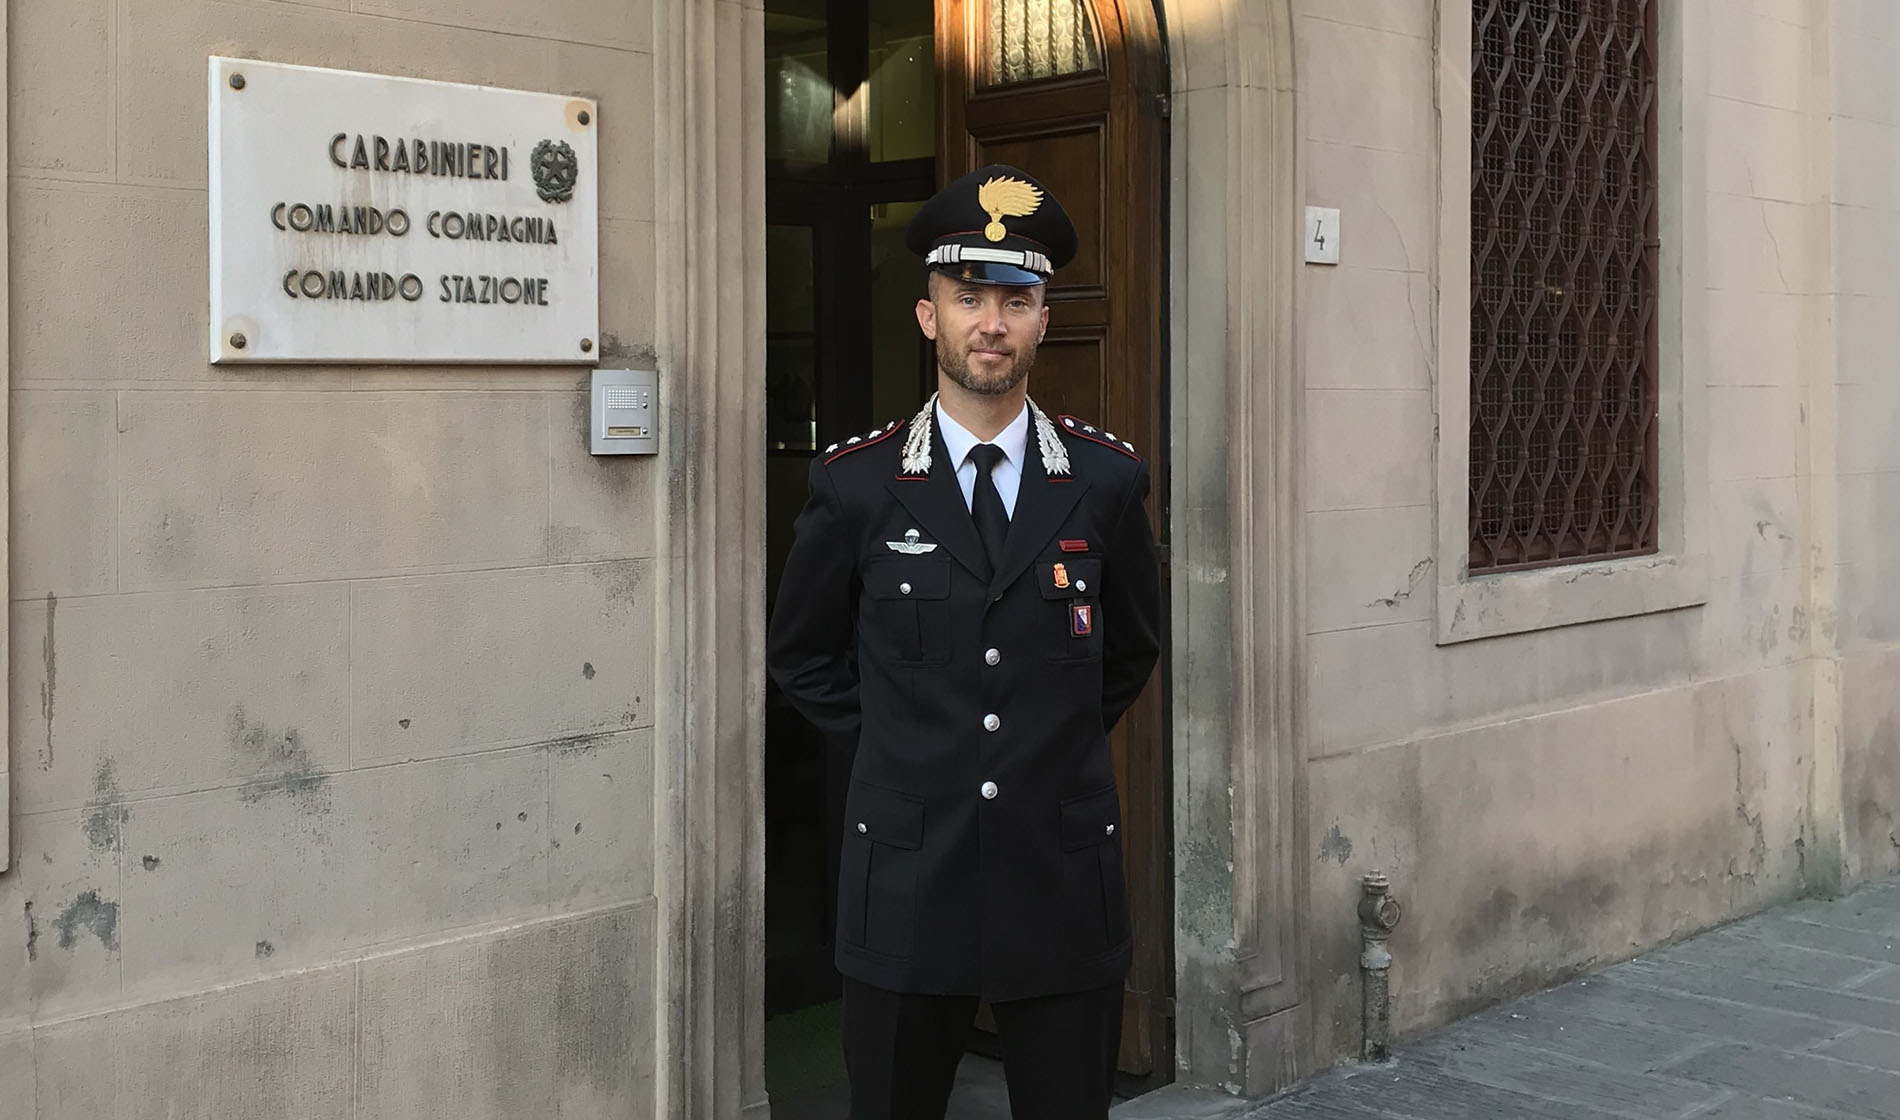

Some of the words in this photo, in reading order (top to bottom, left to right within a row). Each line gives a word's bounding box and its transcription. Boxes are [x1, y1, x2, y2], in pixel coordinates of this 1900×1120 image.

[329, 132, 508, 181] CARABINIERI
[271, 202, 410, 237] COMANDO
[426, 210, 558, 245] COMPAGNIA
[1313, 220, 1325, 250] 4
[282, 269, 423, 301] COMANDO
[439, 274, 549, 306] STAZIONE
